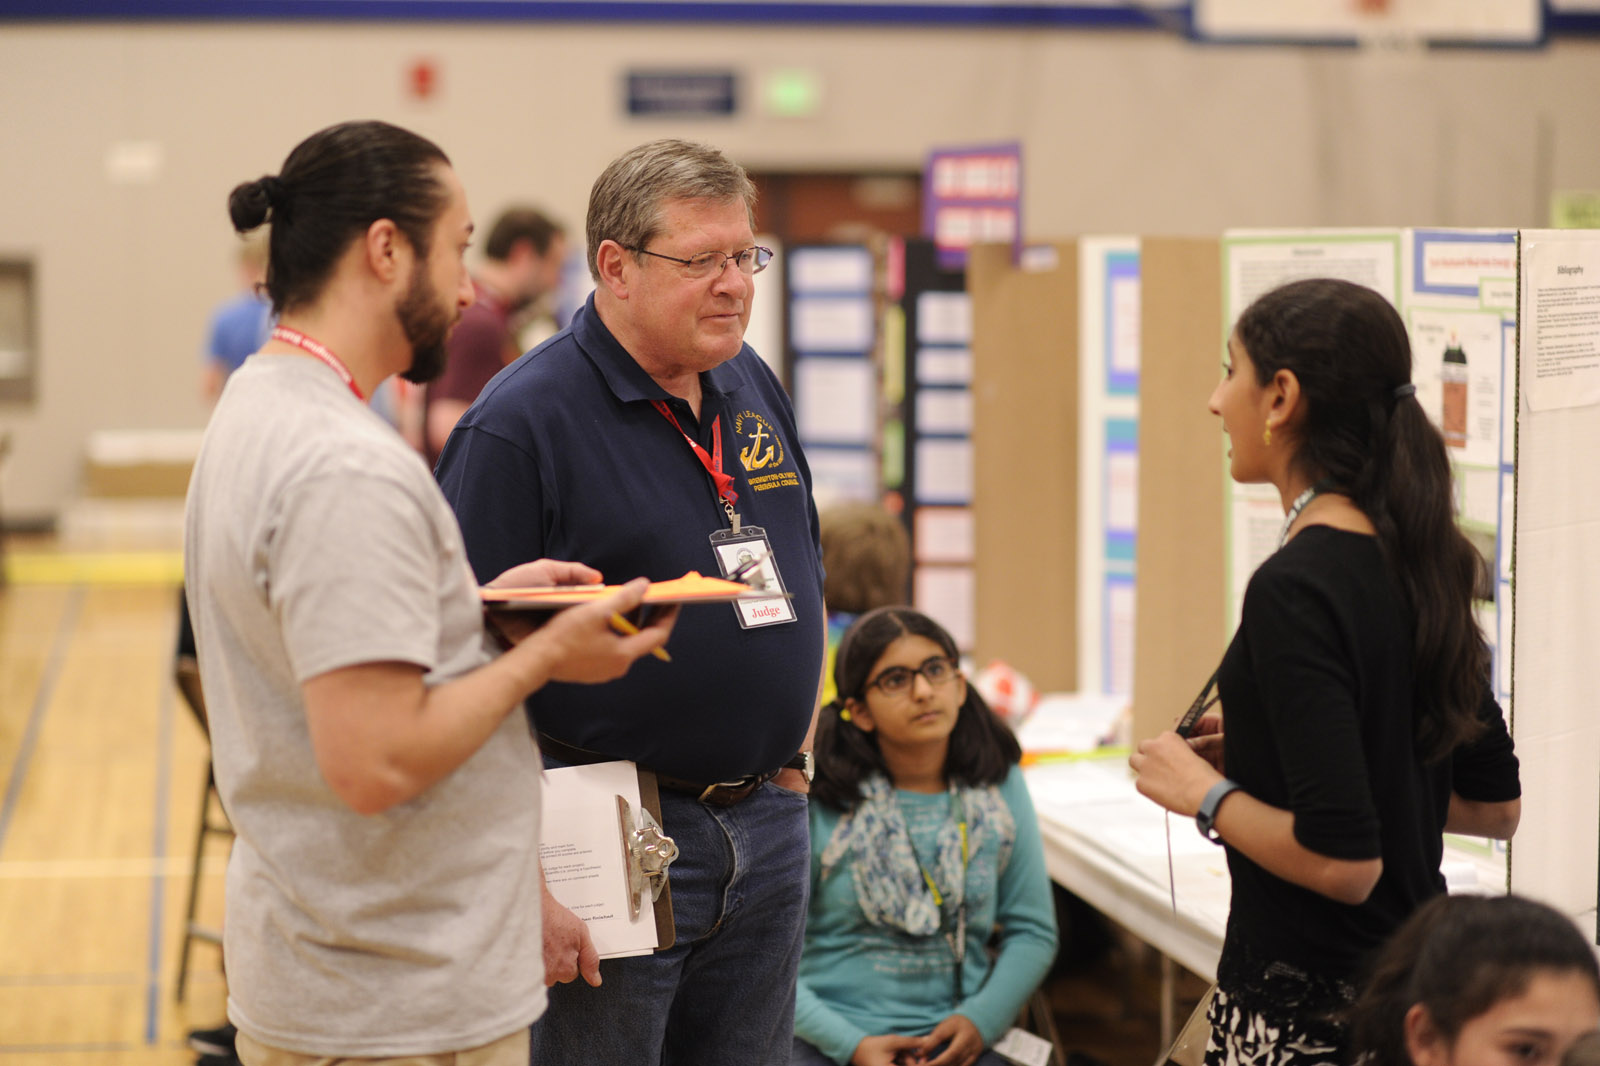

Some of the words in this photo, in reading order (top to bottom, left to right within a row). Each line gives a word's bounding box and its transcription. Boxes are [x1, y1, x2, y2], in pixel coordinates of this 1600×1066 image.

[1557, 265, 1584, 276] Bibliography
[735, 412, 745, 435] NAVY
[742, 410, 774, 432] LEAGUE
[748, 472, 798, 486] BREMERTON-OLYMPIC
[753, 481, 781, 492] PENINSULA
[781, 479, 799, 487] COUNCIL
[752, 605, 781, 619] Judge
